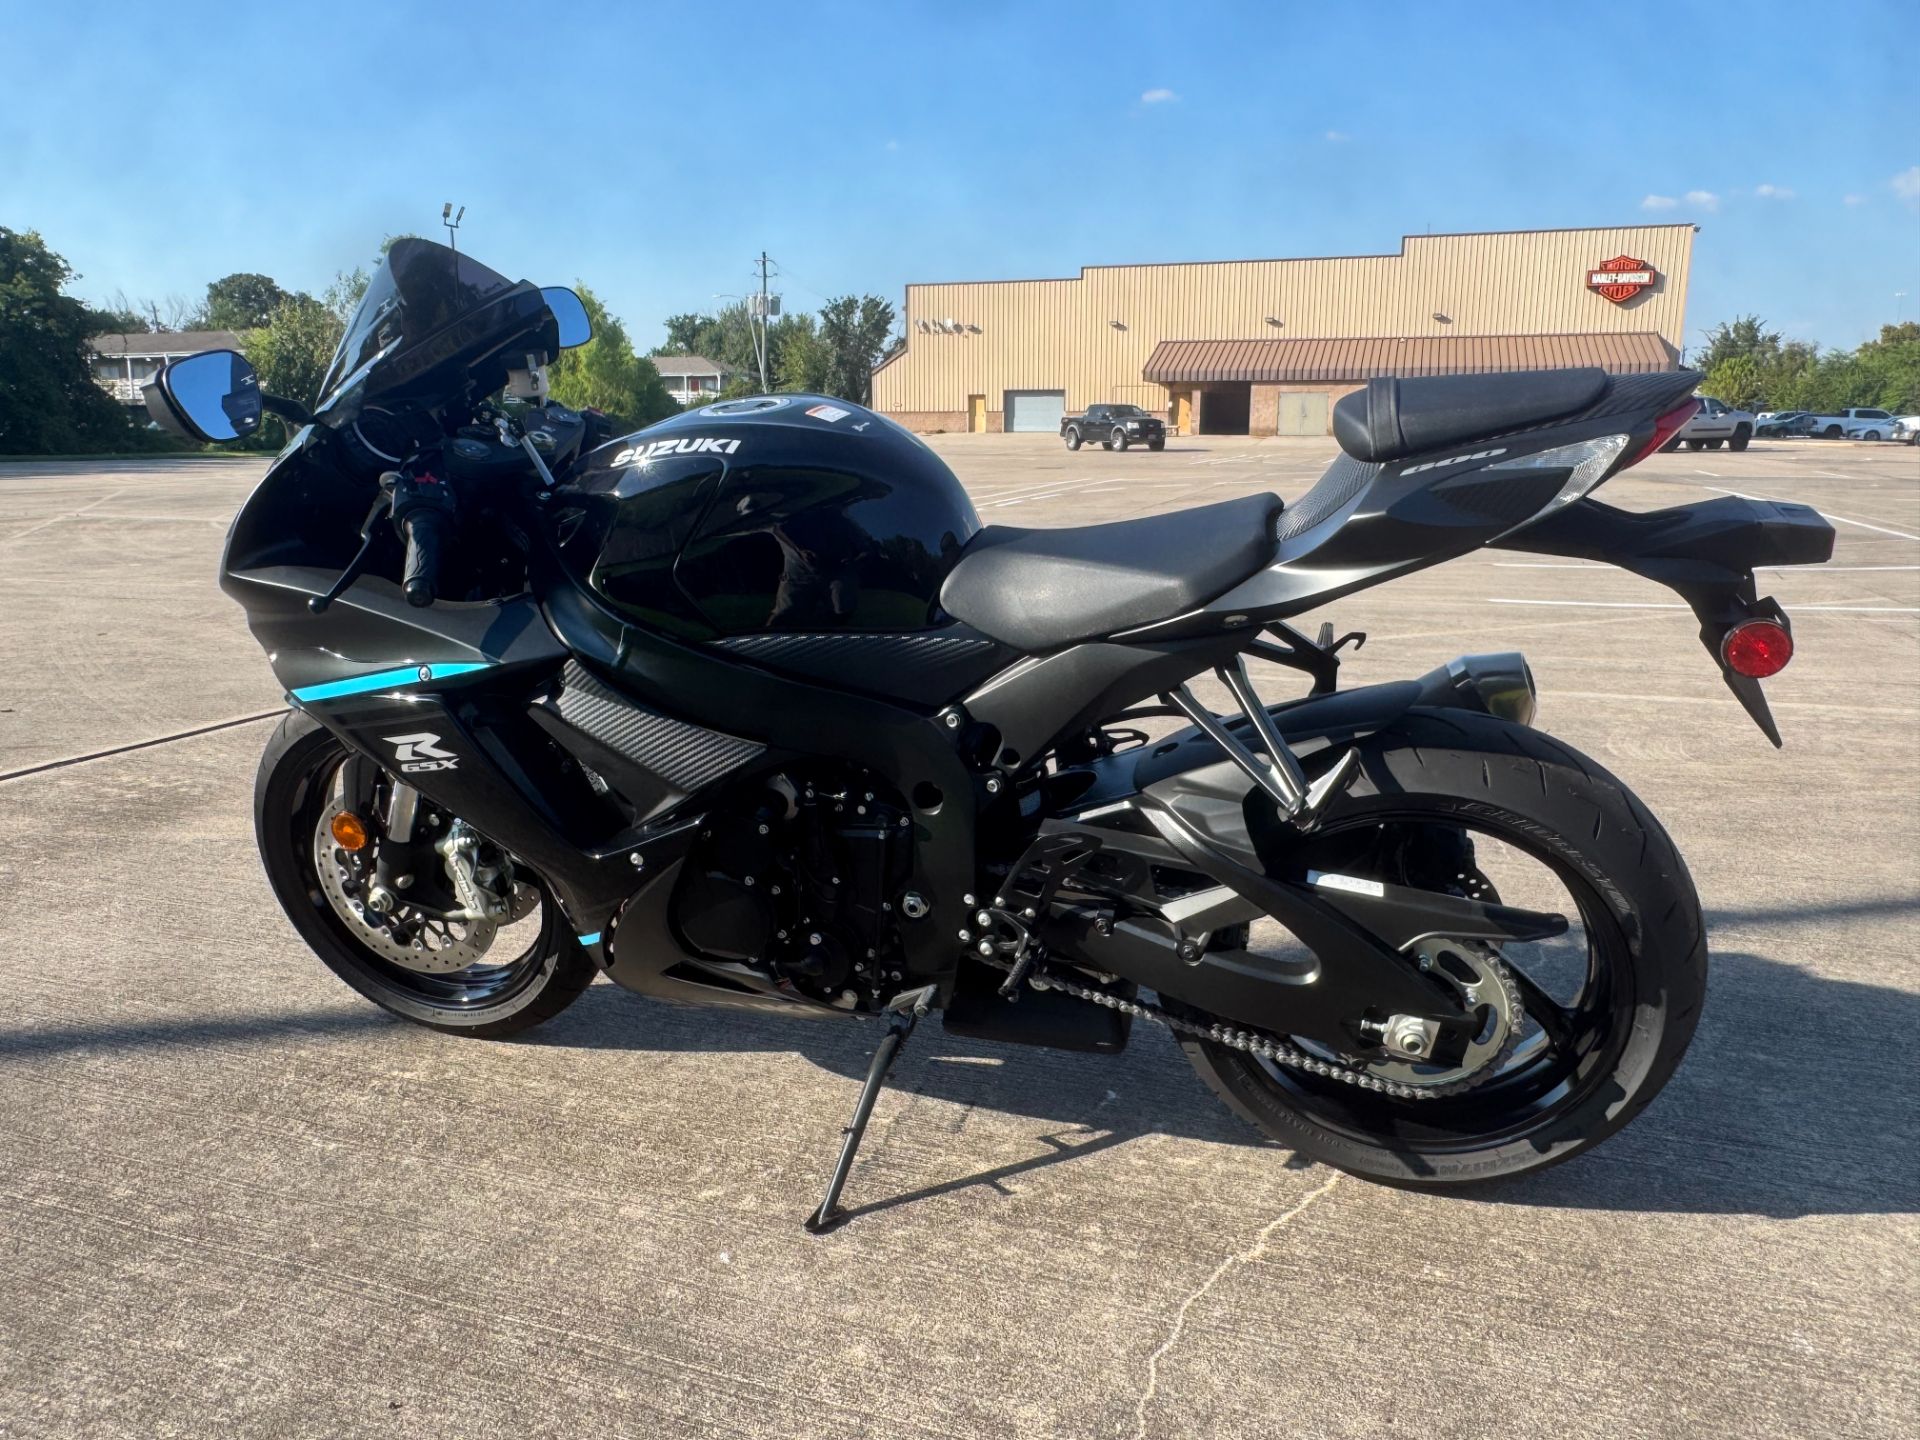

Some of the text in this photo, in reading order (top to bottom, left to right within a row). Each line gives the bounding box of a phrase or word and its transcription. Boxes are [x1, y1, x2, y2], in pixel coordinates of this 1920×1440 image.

[1606, 261, 1638, 270] MOTOR
[610, 438, 741, 468] SUZUKI
[401, 758, 460, 772] GSX
